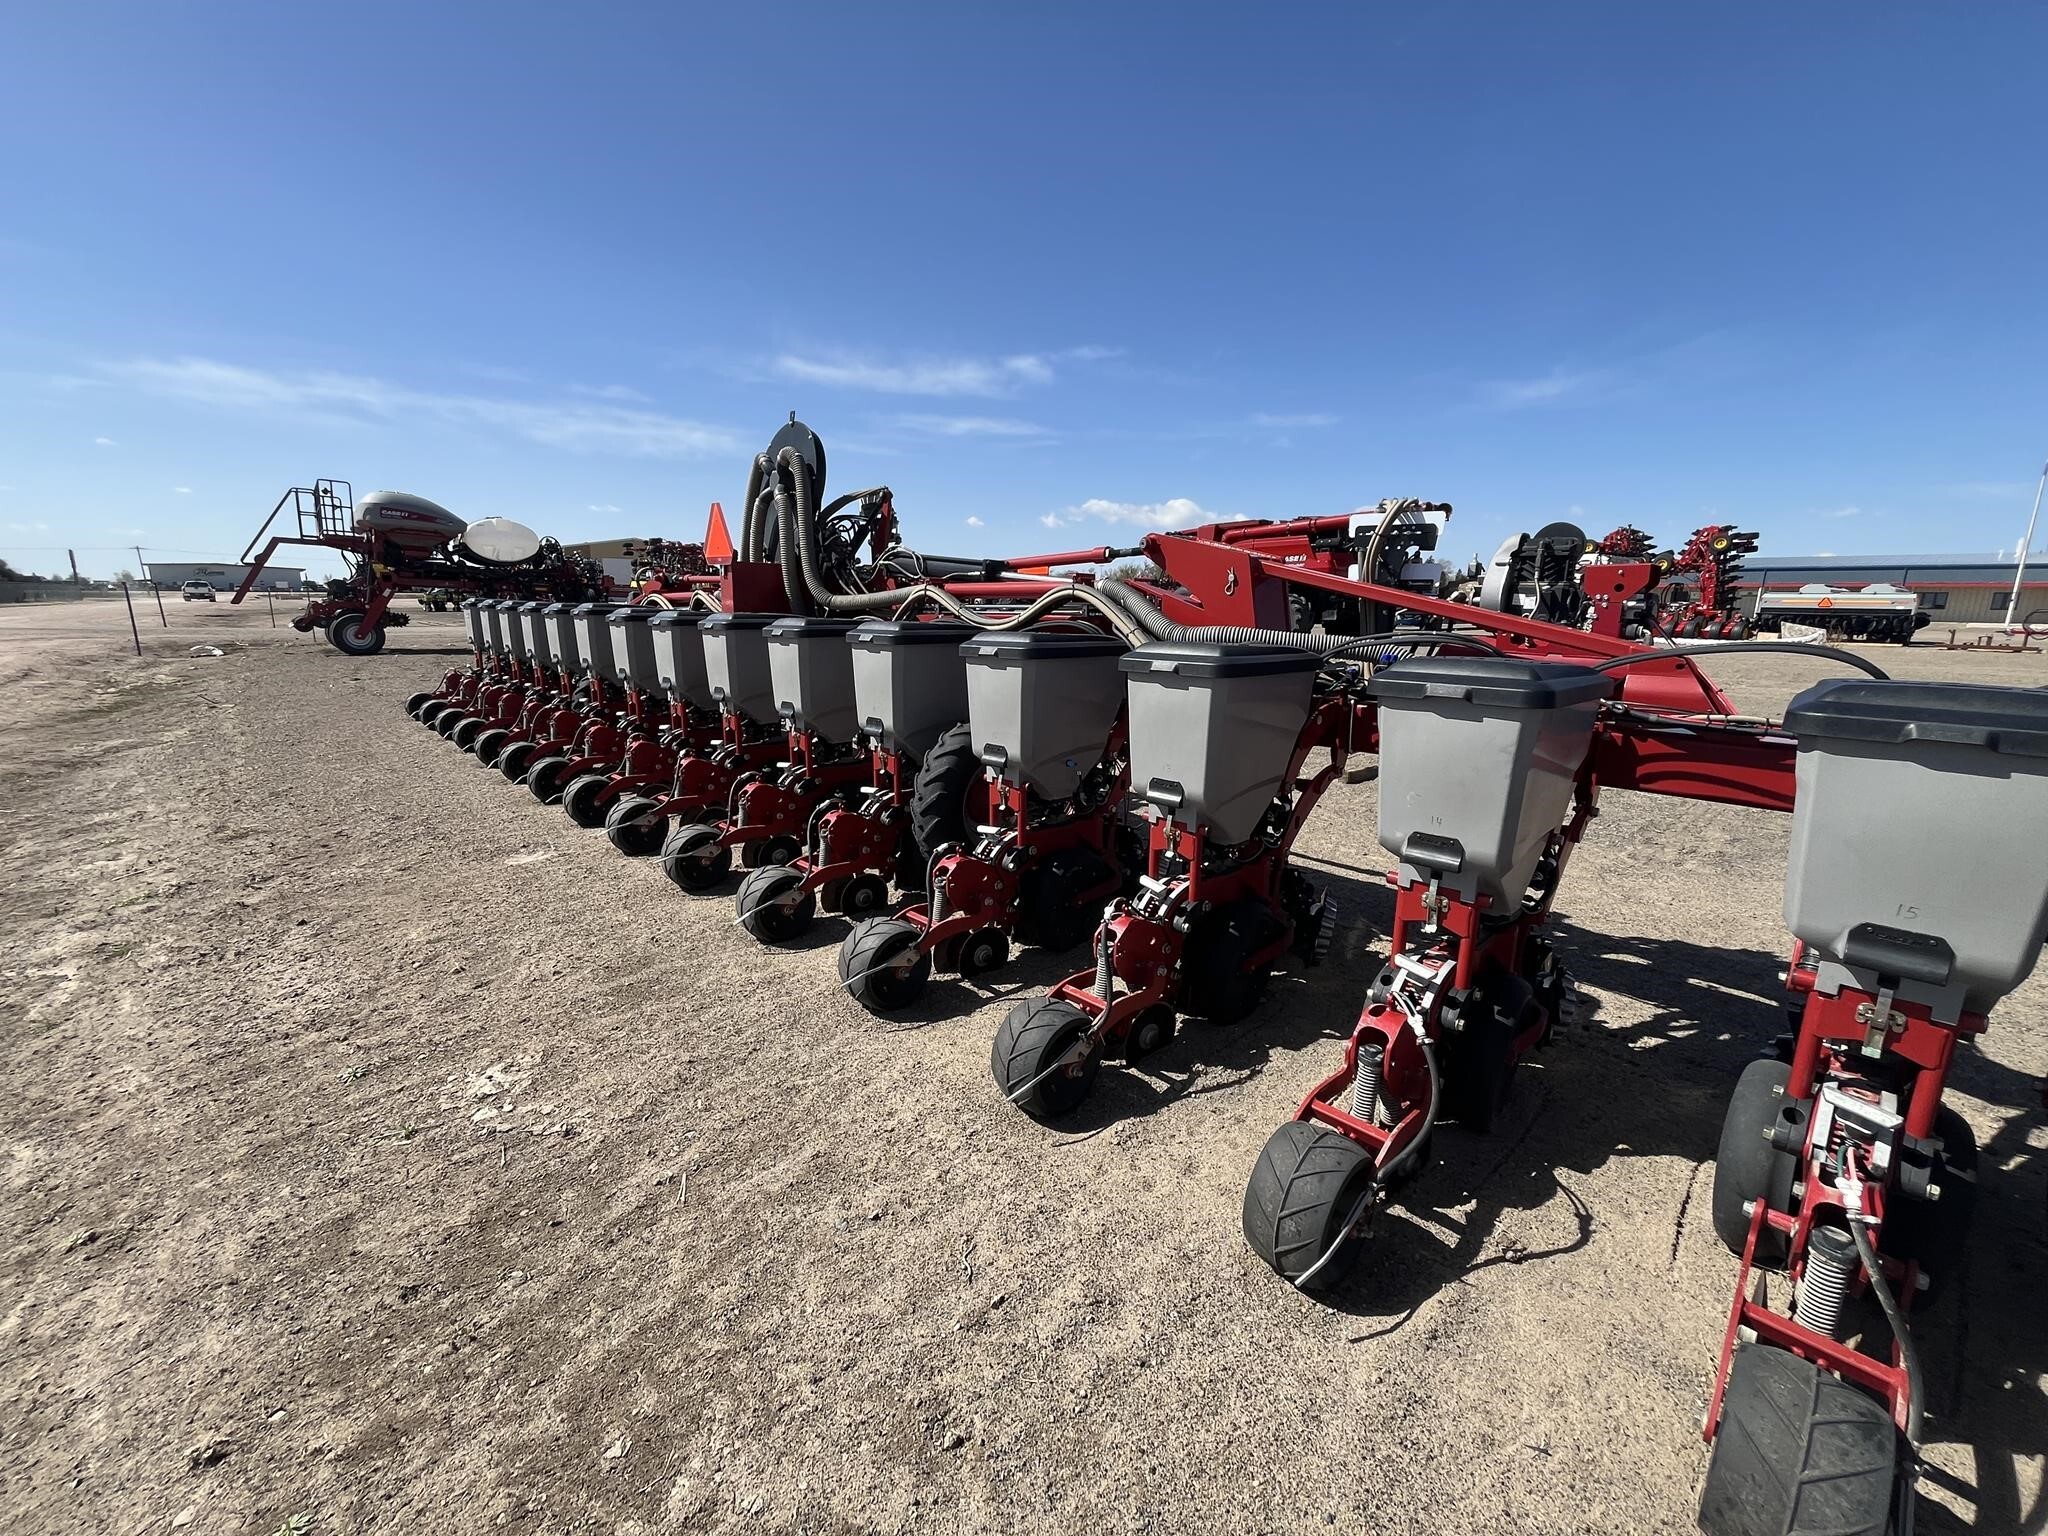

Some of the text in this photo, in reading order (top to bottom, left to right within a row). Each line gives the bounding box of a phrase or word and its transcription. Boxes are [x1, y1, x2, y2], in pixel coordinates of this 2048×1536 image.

[381, 509, 401, 517] CASE
[1431, 815, 1442, 828] 14
[1896, 904, 1920, 919] 15
